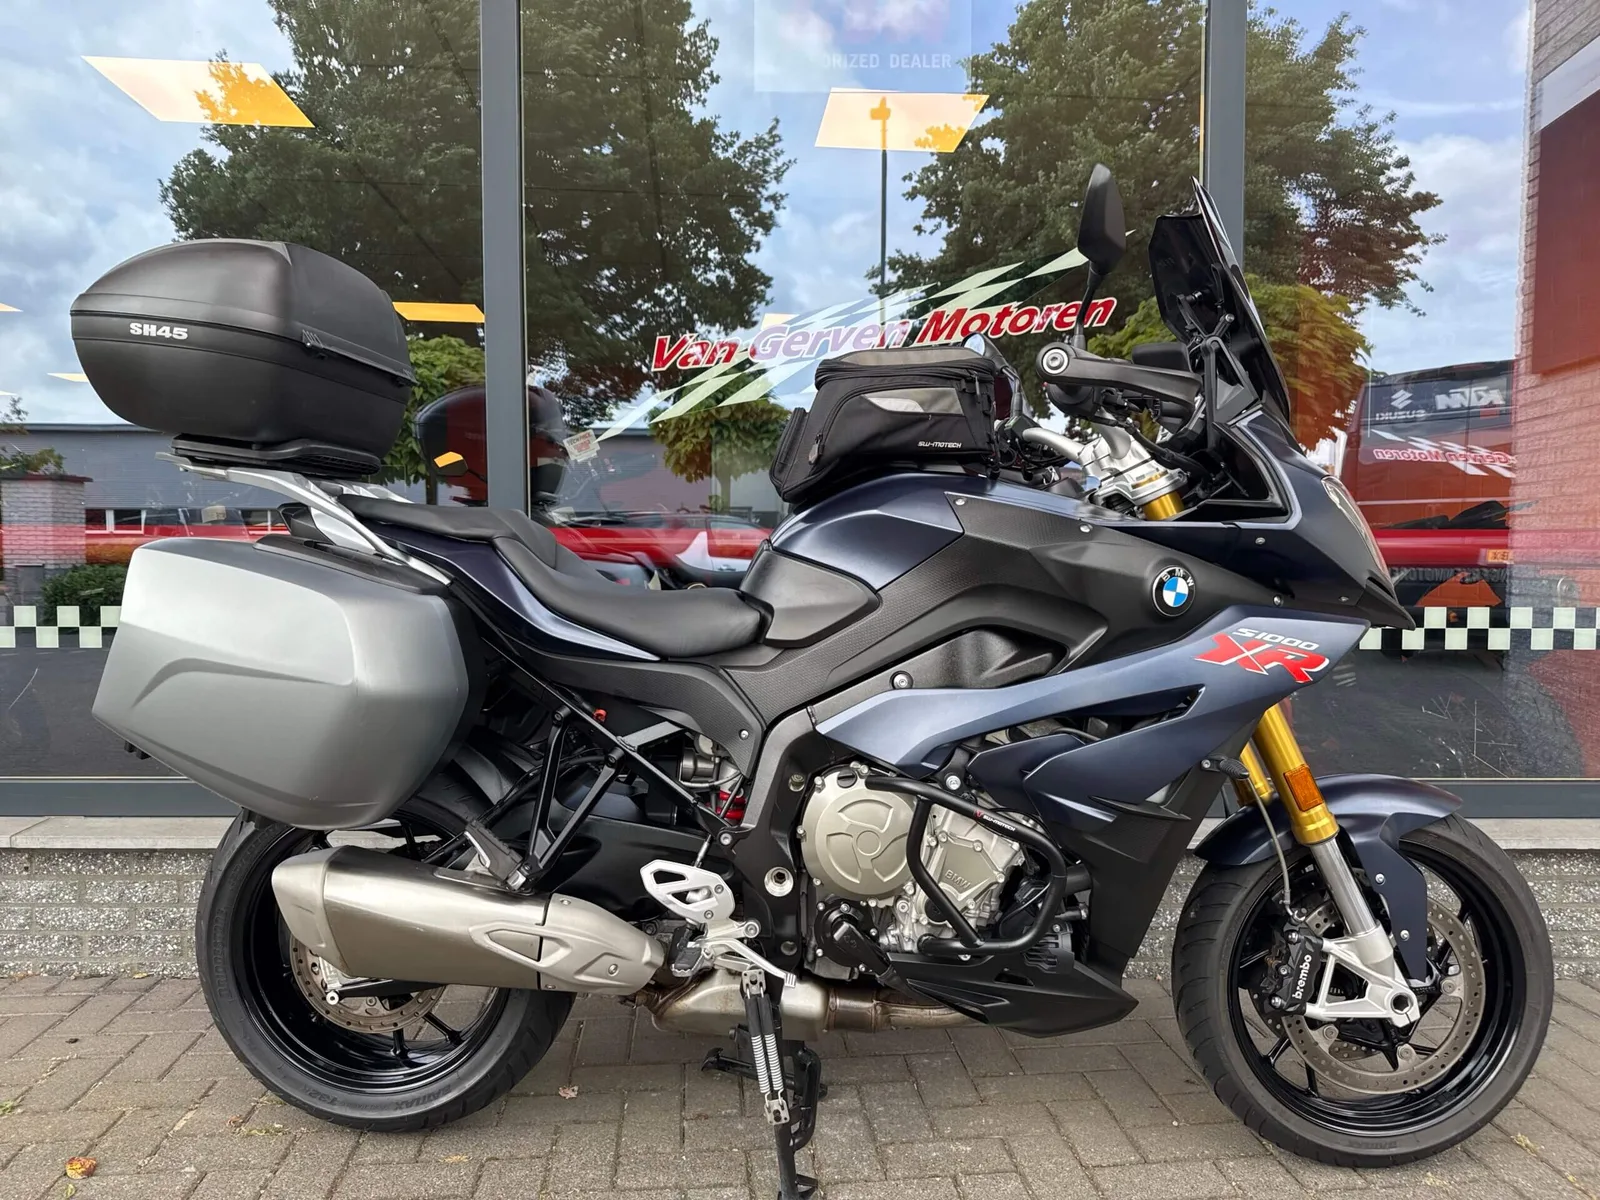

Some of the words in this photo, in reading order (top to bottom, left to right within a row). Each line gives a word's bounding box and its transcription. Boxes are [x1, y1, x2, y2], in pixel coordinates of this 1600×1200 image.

[889, 53, 952, 69] DEALER
[129, 322, 188, 340] SH45
[651, 332, 740, 372] Van
[750, 320, 912, 362] Gerven
[915, 297, 1117, 345] Motoren
[1160, 568, 1195, 587] BMW
[1232, 628, 1320, 651] S1000
[1193, 633, 1330, 684] XR
[945, 869, 971, 888] BMW
[1292, 955, 1312, 999] brembo
